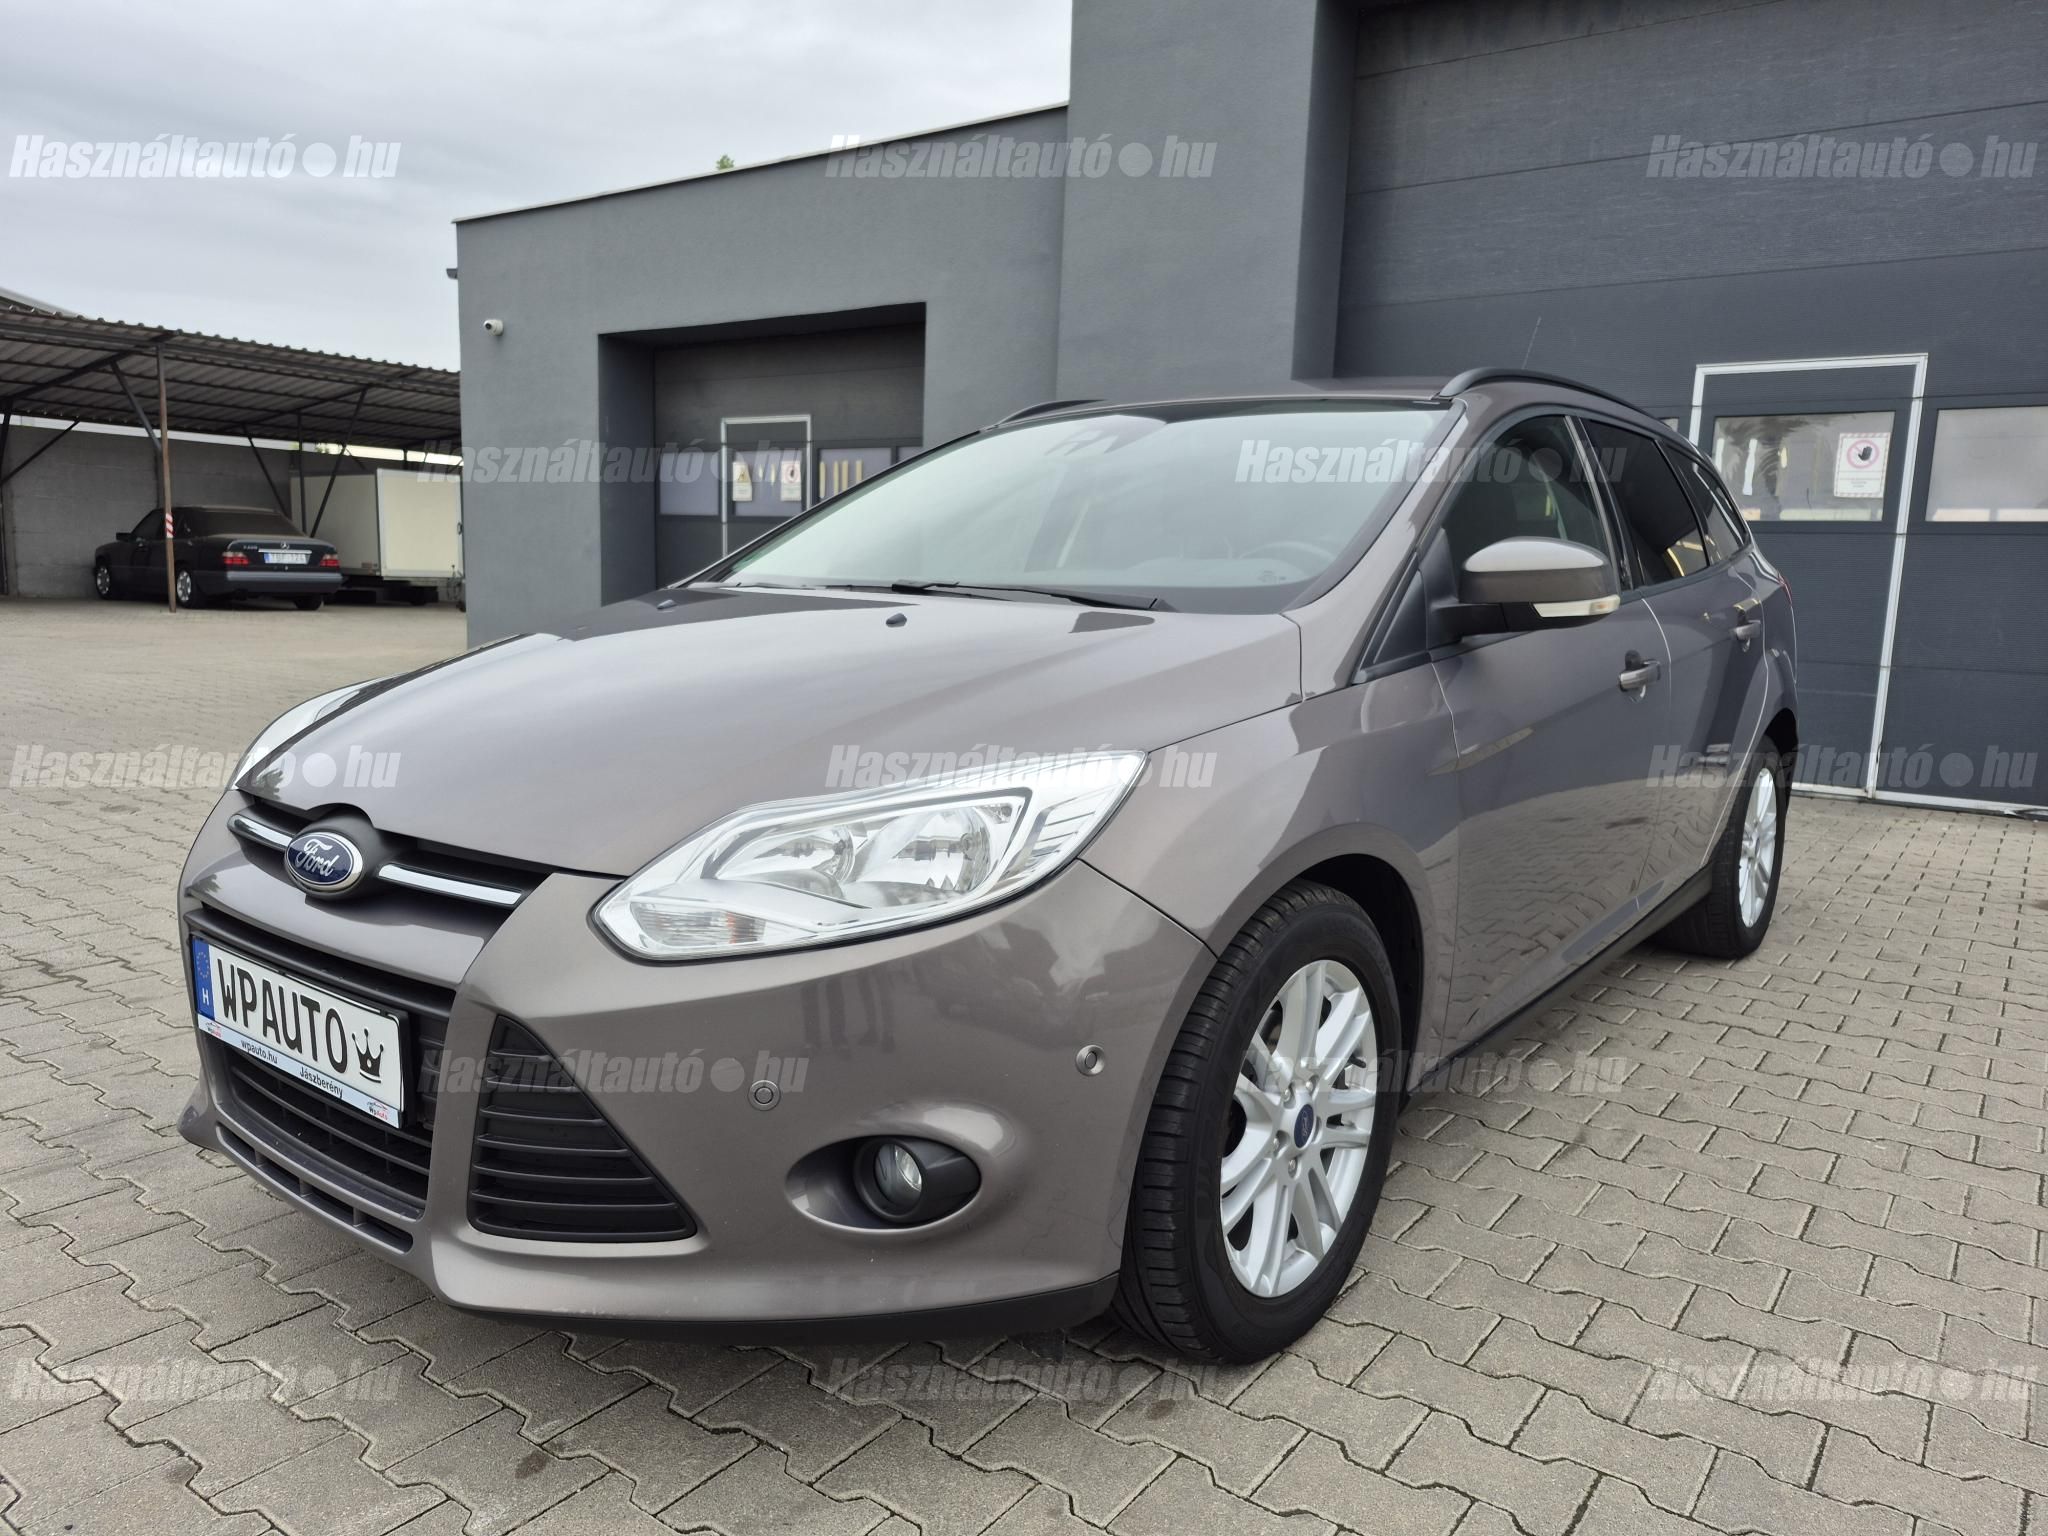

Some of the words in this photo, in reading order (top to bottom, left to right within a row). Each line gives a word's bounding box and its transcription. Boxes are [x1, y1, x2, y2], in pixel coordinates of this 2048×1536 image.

[295, 838, 340, 877] Ford
[202, 987, 210, 1006] H
[217, 958, 348, 1074] WPAUTO
[241, 1039, 278, 1064] wpauto.hu
[300, 1066, 343, 1099] Jászberény
